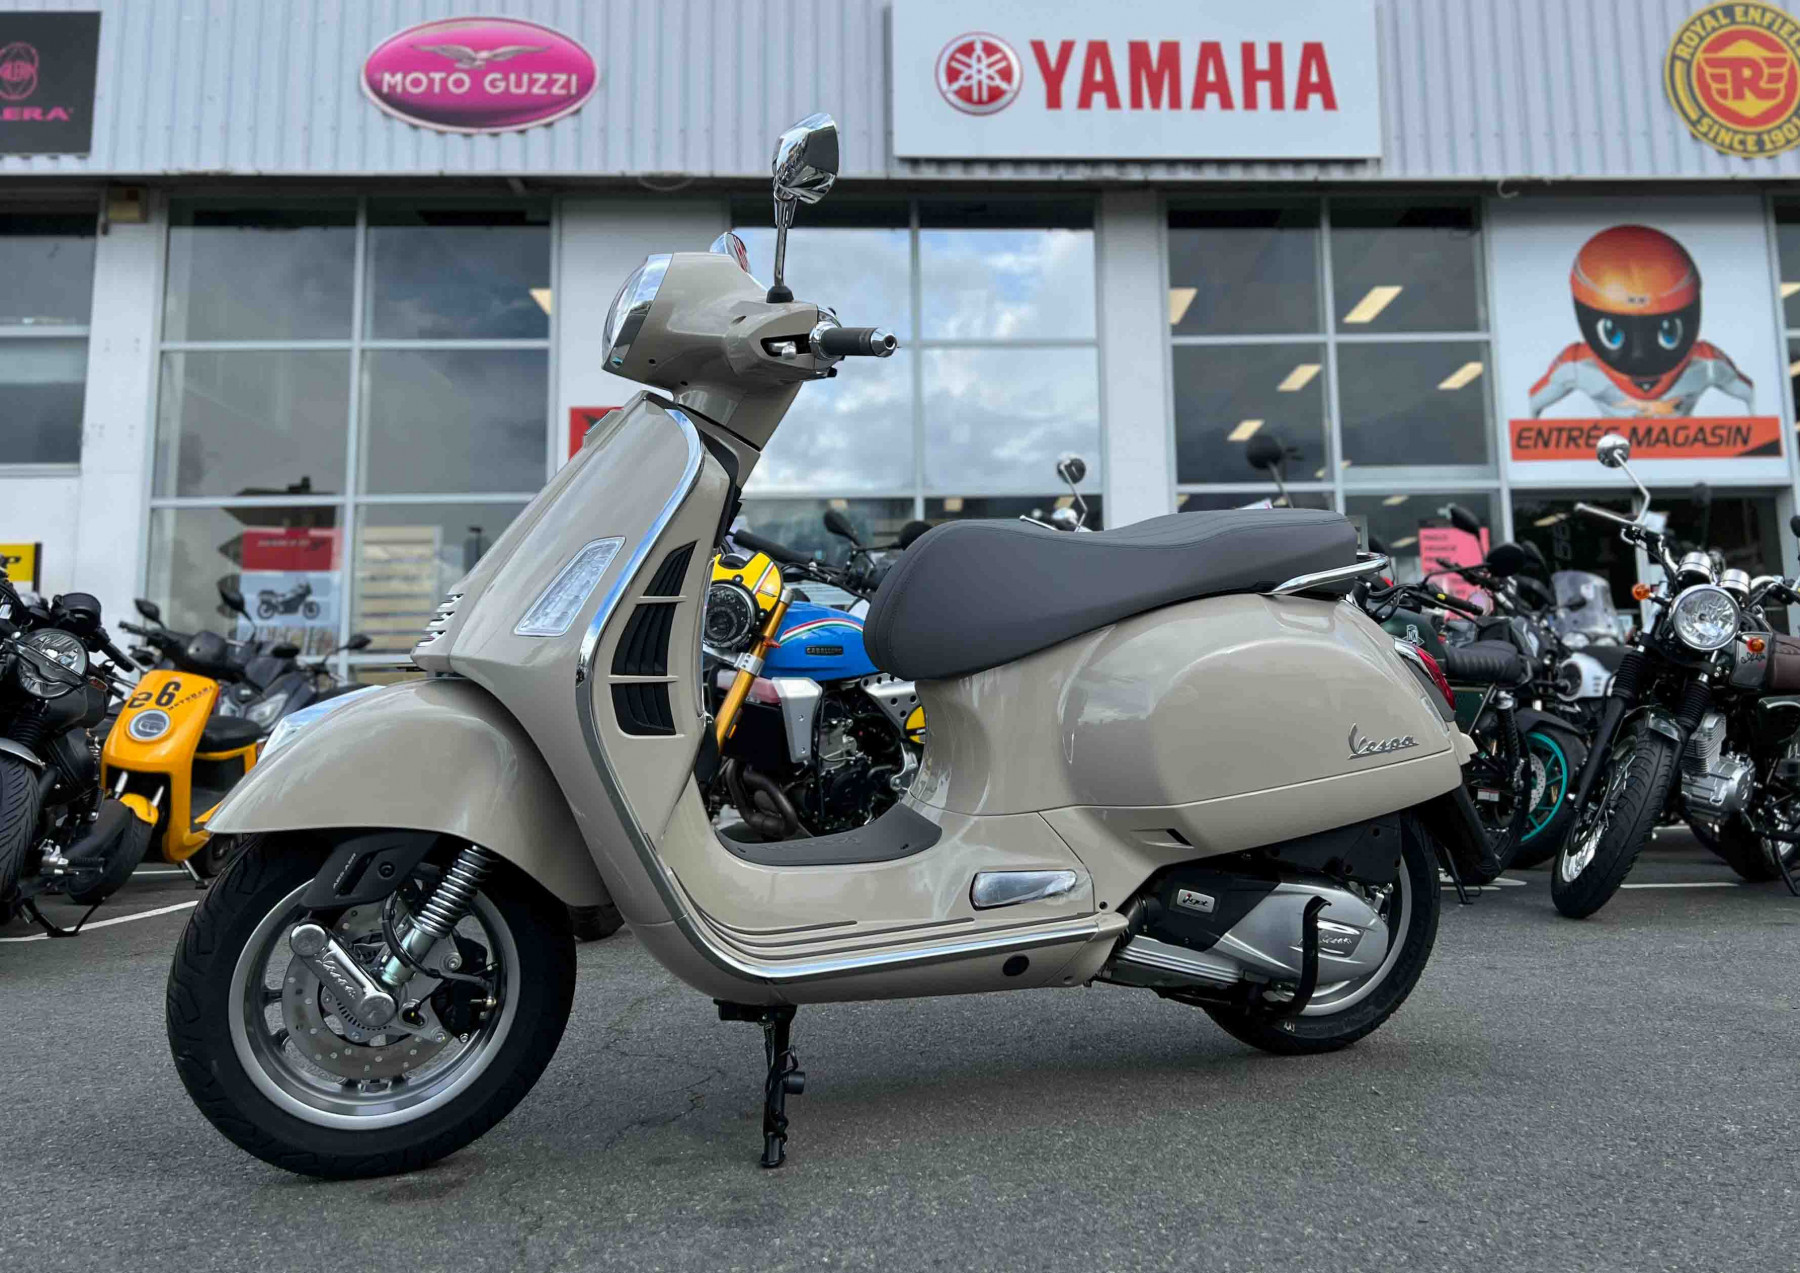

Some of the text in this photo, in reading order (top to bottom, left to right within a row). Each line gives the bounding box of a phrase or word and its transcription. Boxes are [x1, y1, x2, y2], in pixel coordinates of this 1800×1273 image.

[1675, 9, 1730, 60] ROYAL
[381, 72, 578, 95] MOTO GUZZI
[1029, 38, 1338, 111] YAMAHA
[1697, 117, 1759, 151] SINCE
[1629, 424, 1752, 448] MAGASIN
[1347, 722, 1419, 760] Vespa
